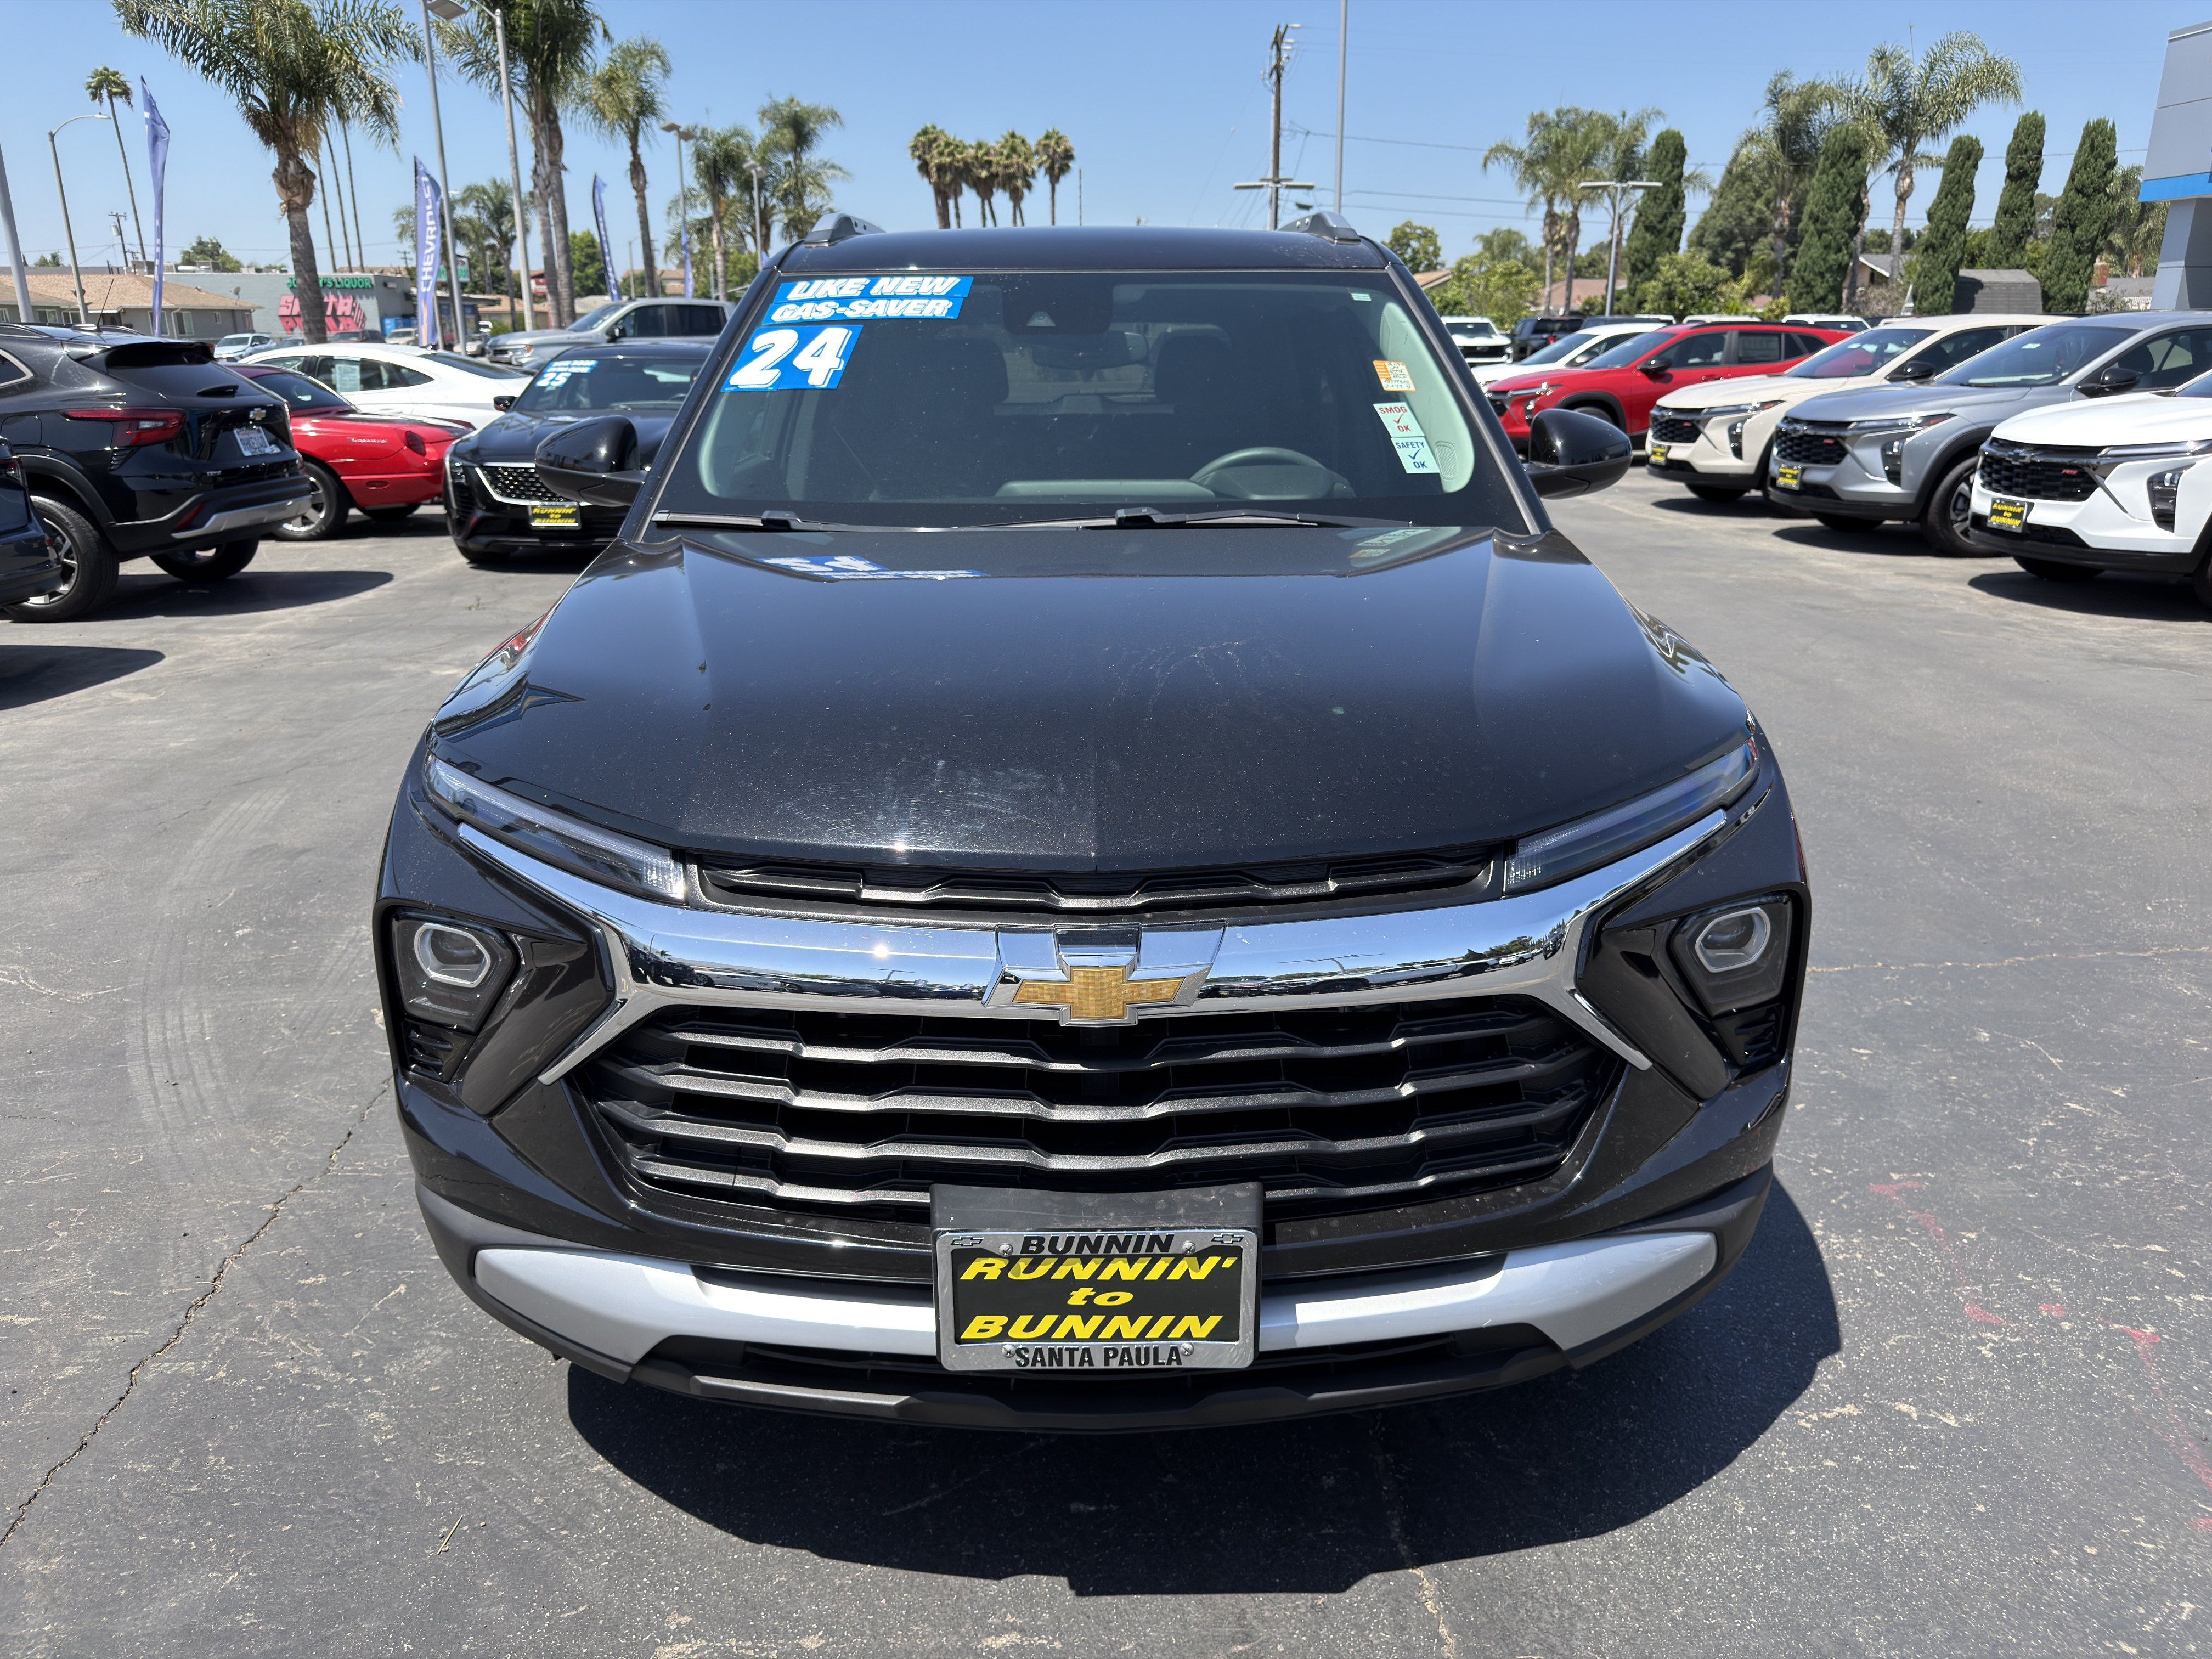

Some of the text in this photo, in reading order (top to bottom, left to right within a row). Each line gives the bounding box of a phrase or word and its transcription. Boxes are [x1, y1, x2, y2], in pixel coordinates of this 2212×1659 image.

[335, 278, 372, 289] LIQUOR
[786, 275, 961, 301] LIKE NEW
[771, 299, 953, 323] GAS-SAVER
[729, 328, 852, 388] 24
[535, 372, 571, 387] 25
[1395, 441, 1425, 449] SAFETY
[1020, 1234, 1175, 1255] BUNNIN
[960, 1256, 1238, 1280] RUNNIN'
[1067, 1287, 1134, 1306] to
[960, 1314, 1223, 1340] BUNNIN
[1015, 1345, 1183, 1368] SANTA PAULA
